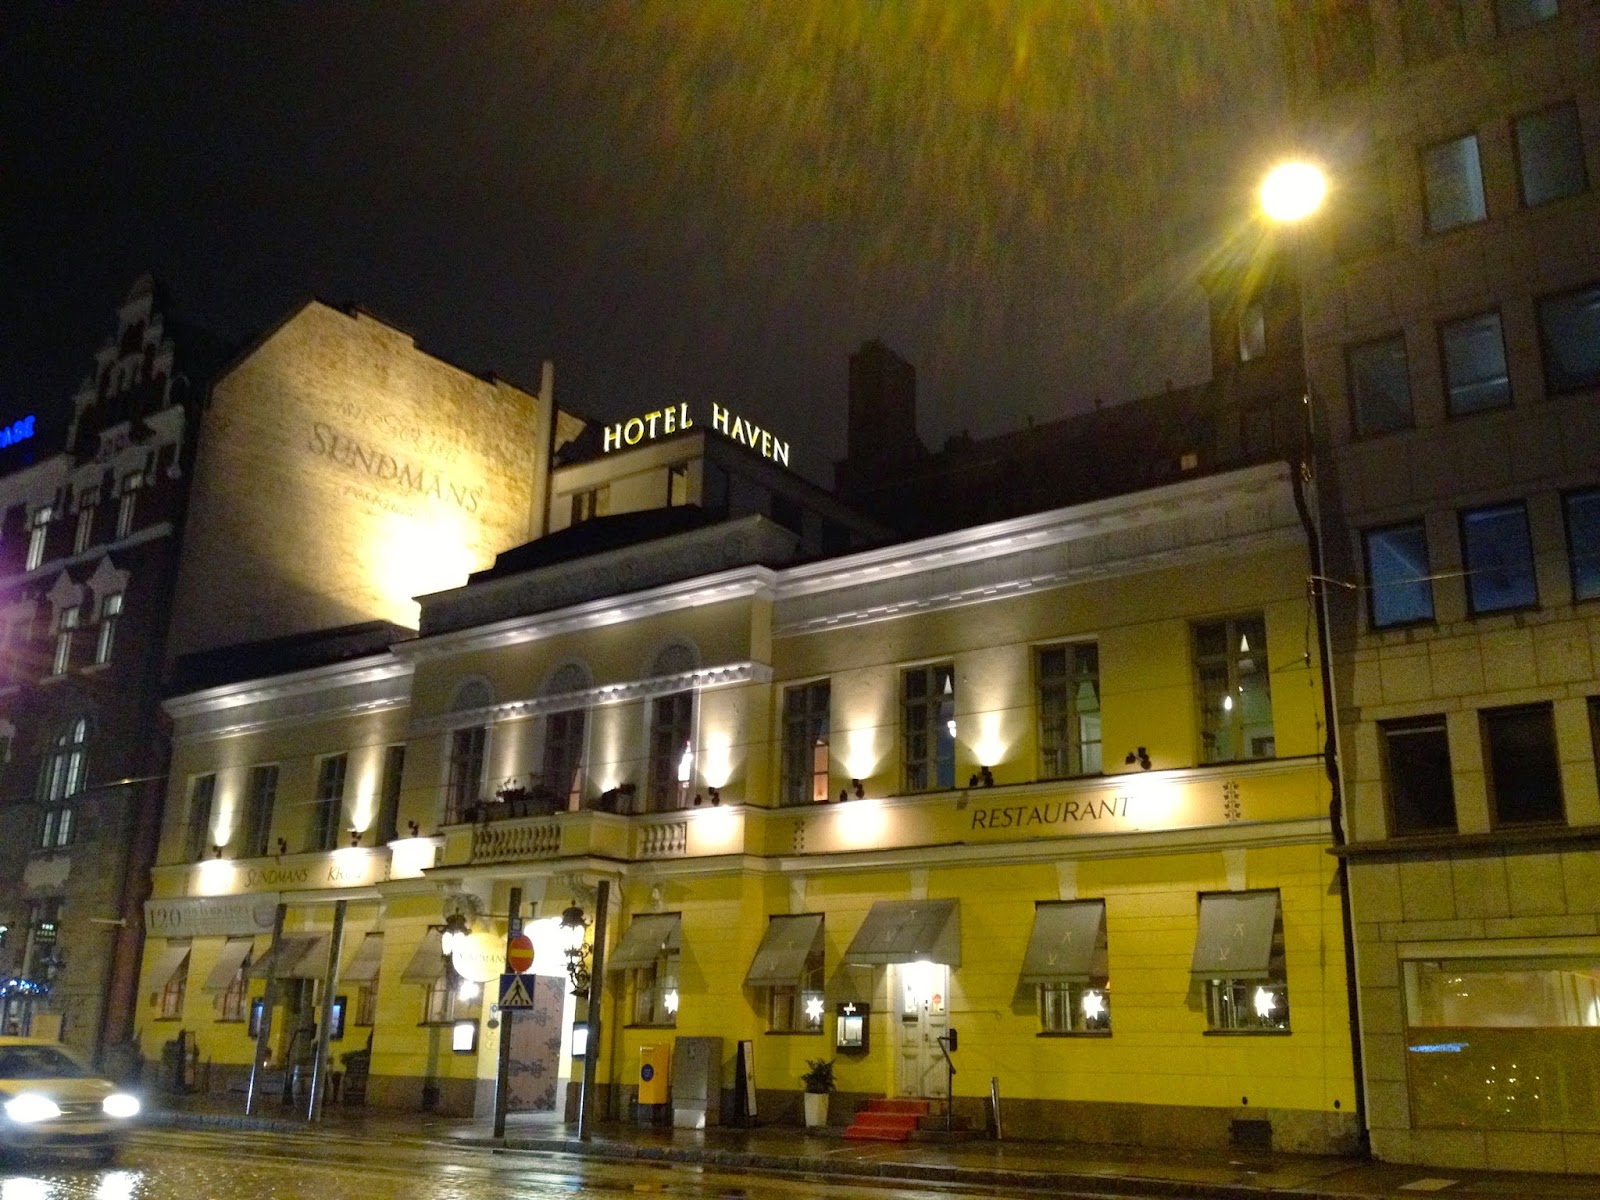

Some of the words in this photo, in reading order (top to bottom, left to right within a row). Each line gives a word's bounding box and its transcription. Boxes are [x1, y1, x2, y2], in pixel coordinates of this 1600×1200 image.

[308, 421, 484, 513] SUNDMANS
[603, 402, 693, 453] HOTEL
[712, 402, 790, 468] HAVEN
[971, 796, 1134, 830] RESTAURANT
